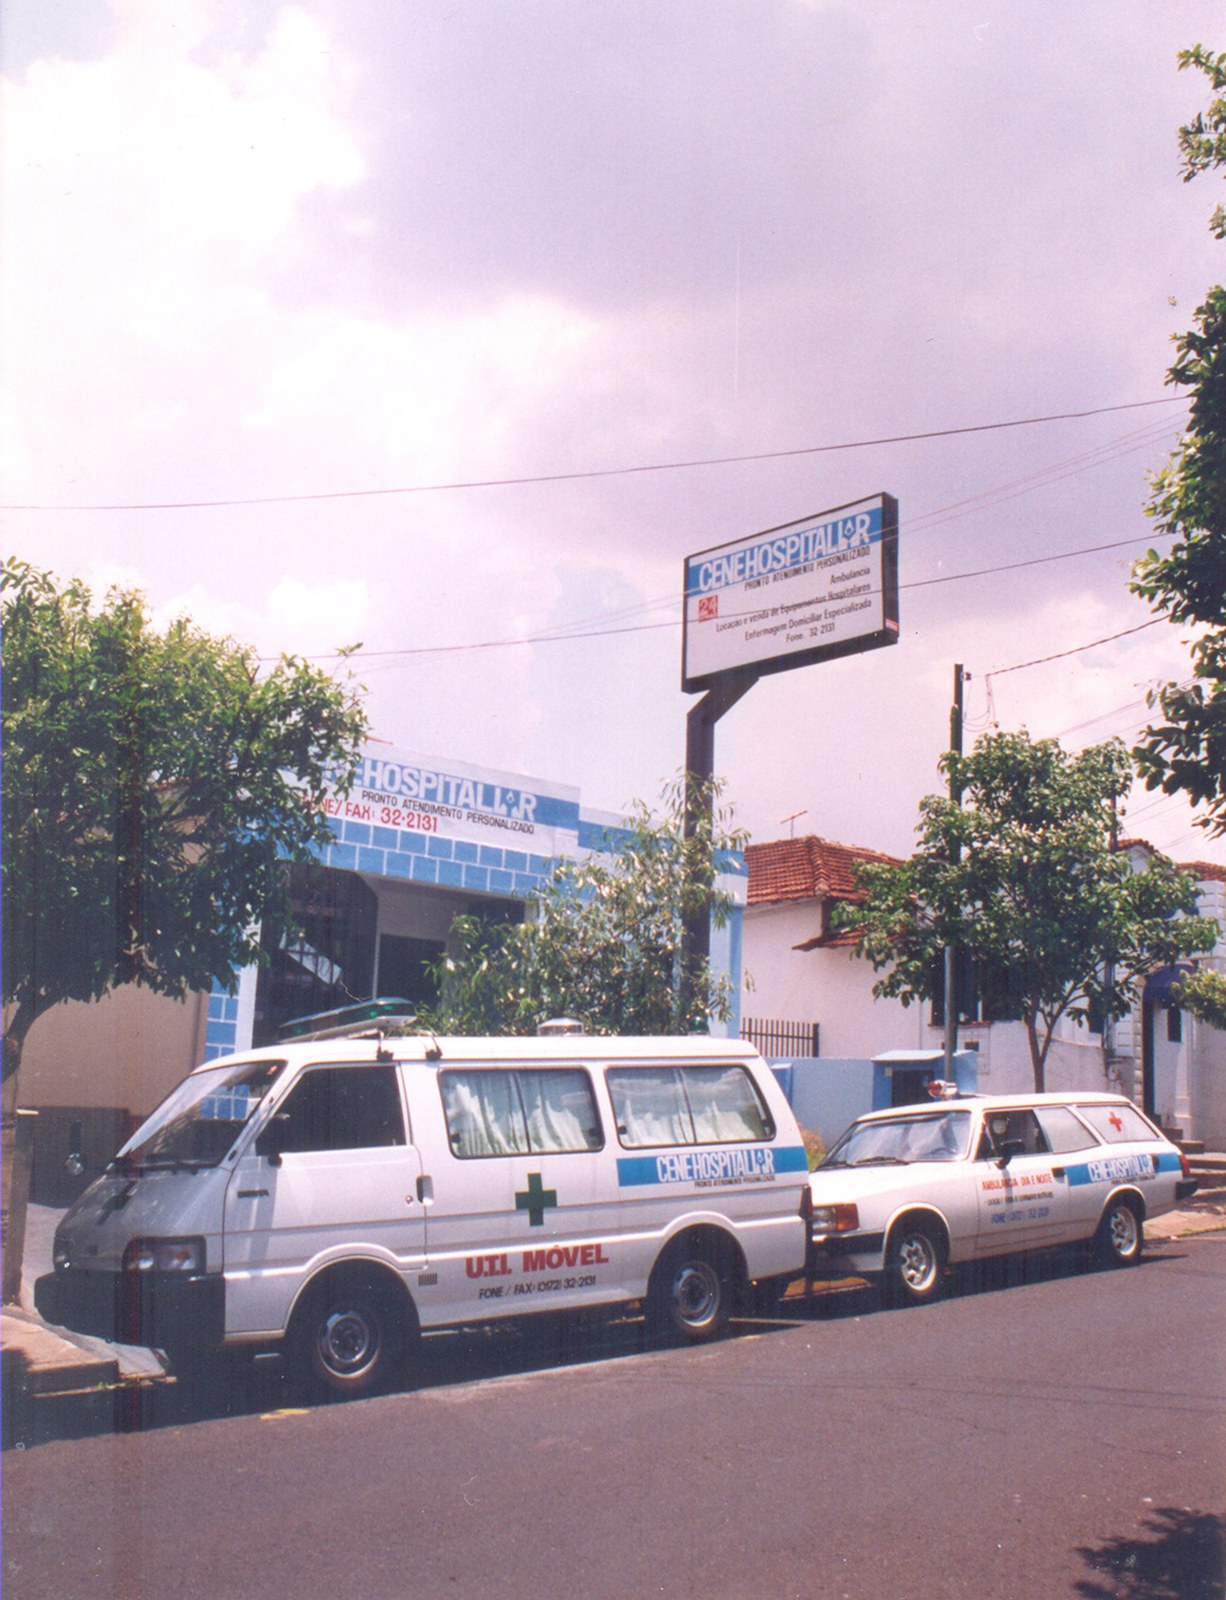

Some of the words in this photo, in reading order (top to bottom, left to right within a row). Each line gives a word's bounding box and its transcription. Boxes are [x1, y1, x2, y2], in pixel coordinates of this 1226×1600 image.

[744, 576, 770, 592] PRONTO
[772, 562, 814, 583] ATENDIMENTO
[817, 545, 871, 570] PERSONALIZADO
[749, 609, 769, 623] venda
[771, 607, 779, 617] de
[828, 583, 871, 602] Hospitalares
[745, 620, 787, 641] Enfermagem
[789, 611, 822, 630] Domiciliar
[362, 789, 398, 807] PRONTO
[402, 798, 463, 819] ATENDIMENTO
[466, 811, 534, 835] PERSONALIZADO
[465, 1254, 512, 1279] U.T.I.
[479, 1287, 503, 1299] FONE
